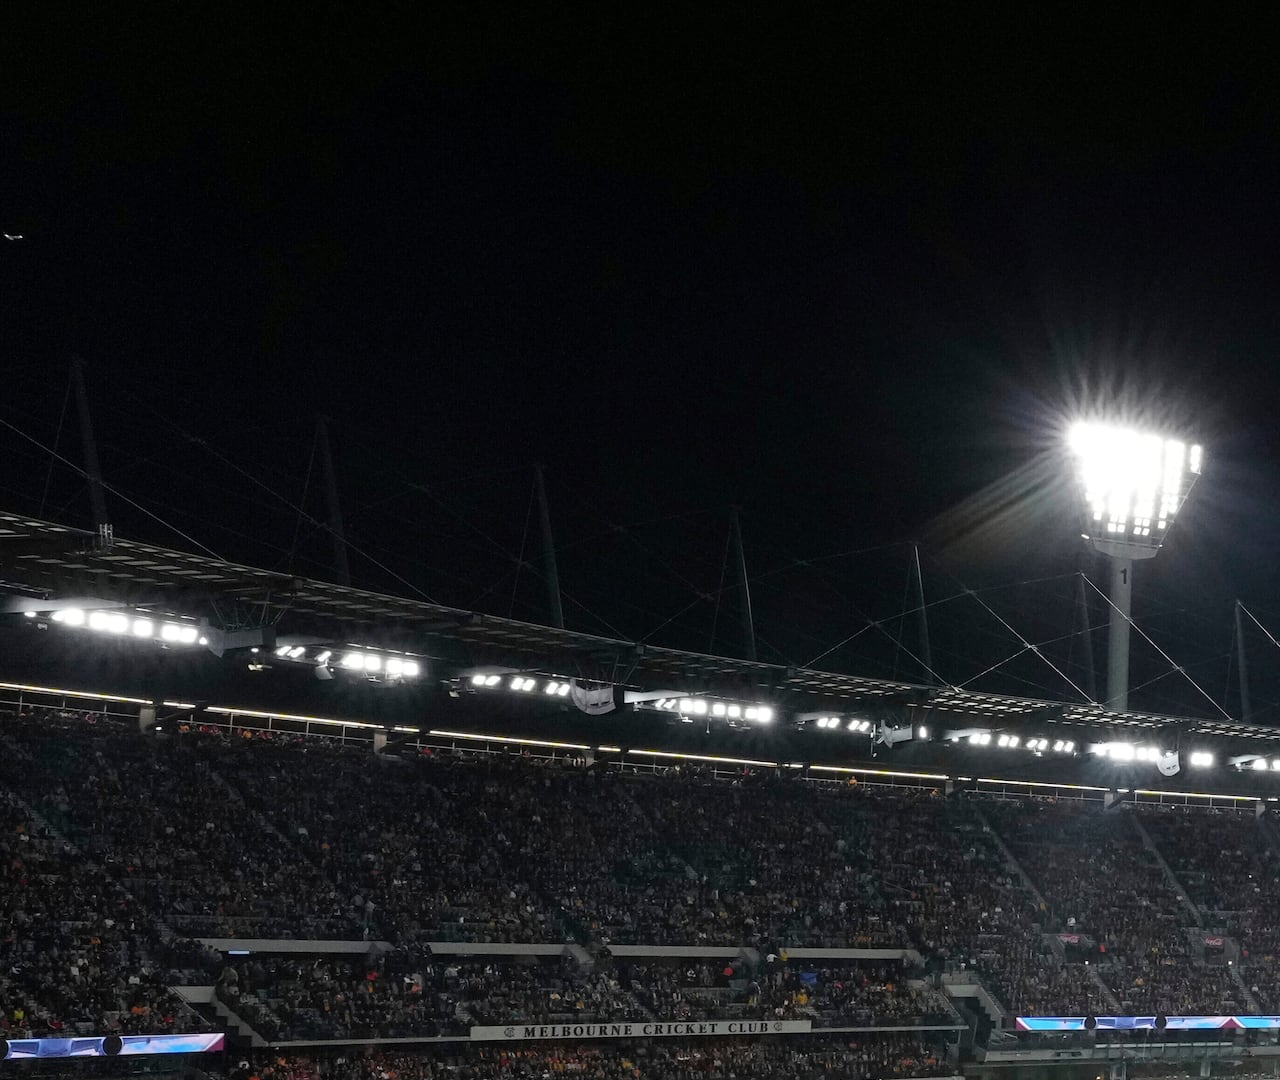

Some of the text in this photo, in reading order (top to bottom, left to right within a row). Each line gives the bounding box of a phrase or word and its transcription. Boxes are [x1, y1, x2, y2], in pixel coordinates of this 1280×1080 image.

[523, 1022, 769, 1038] MELBOURNE CRICKET CLUB
